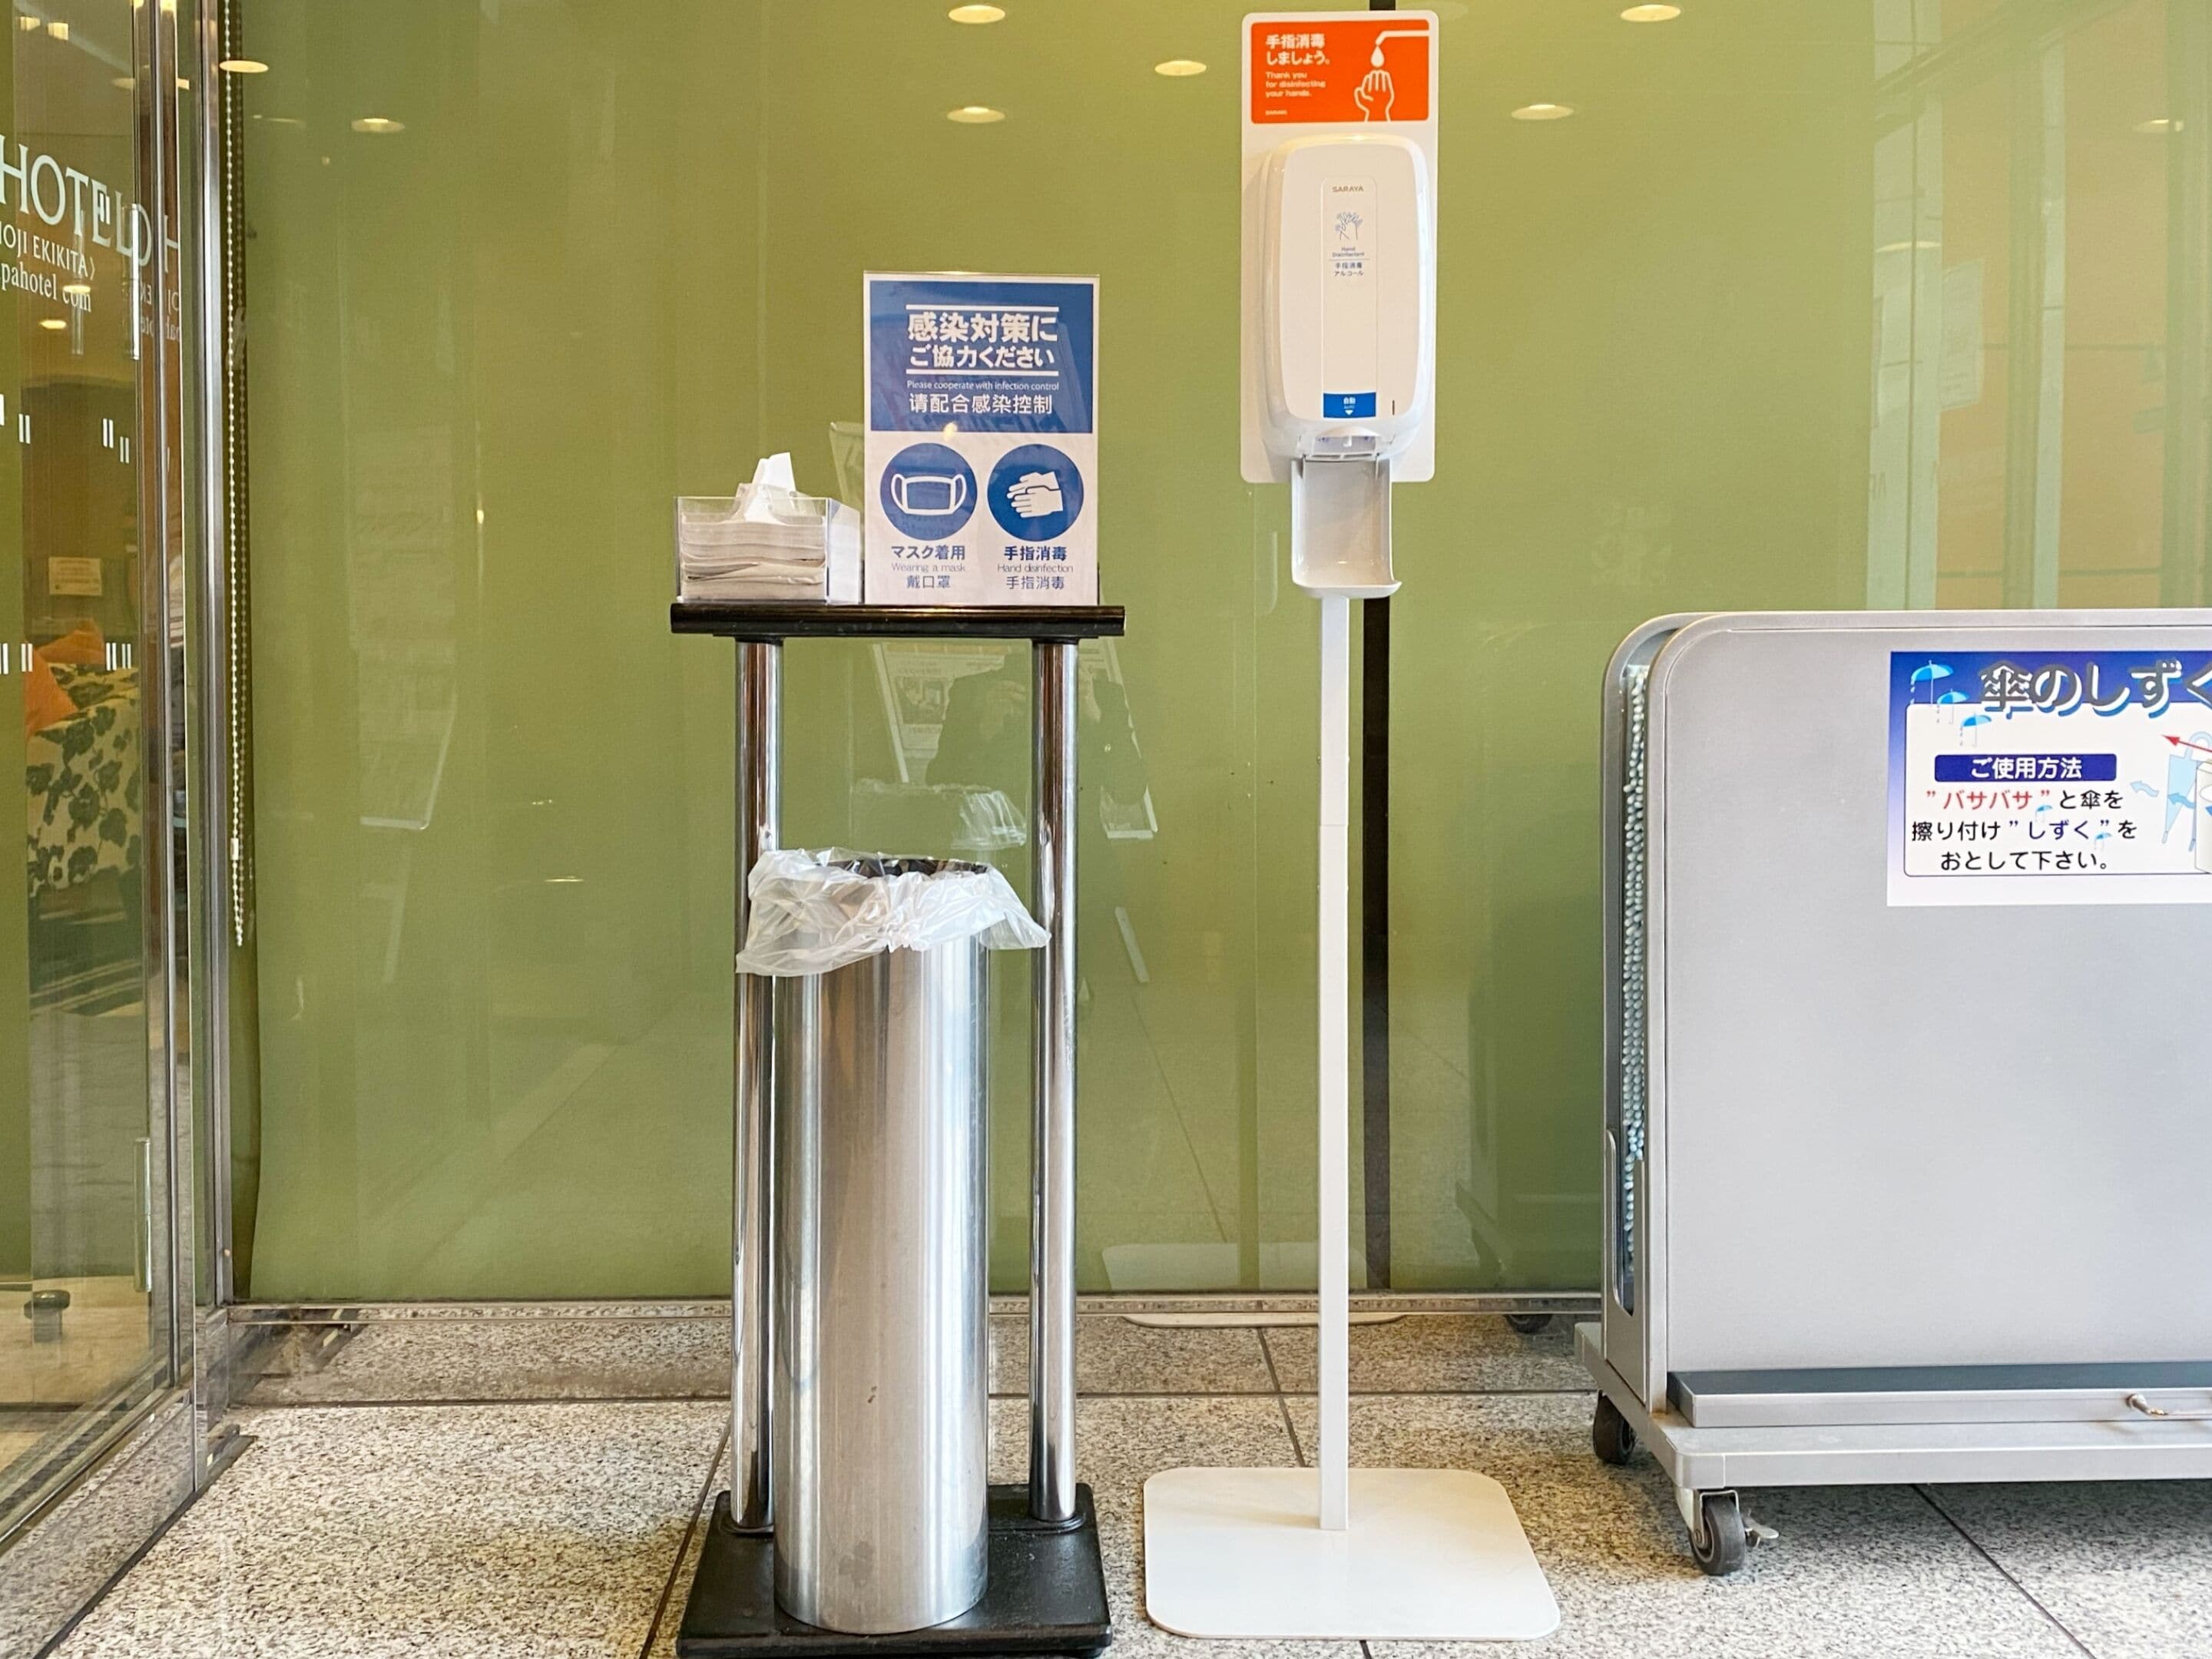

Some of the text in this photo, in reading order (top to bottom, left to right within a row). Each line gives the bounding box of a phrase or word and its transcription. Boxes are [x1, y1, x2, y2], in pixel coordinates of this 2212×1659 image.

[1266, 33, 1325, 49] 手指消毒
[1267, 50, 1330, 65] しましょう。
[1266, 71, 1290, 79] Thank
[0, 220, 28, 258] OJI
[908, 312, 1058, 343] 感染対策に
[910, 344, 1055, 369] ご協力ください
[907, 380, 1059, 391] Please cooperate with infection control
[909, 393, 1052, 415] 请配合感染控制
[891, 545, 965, 560] マスク着用
[1004, 545, 1067, 561] 手指消毒
[891, 563, 929, 573] Wearing
[941, 563, 966, 571] mask
[998, 563, 1074, 572] Hand disinfection
[906, 575, 951, 589] 戴口罩
[1006, 576, 1065, 590] 手指消毒
[1971, 757, 2082, 780] ご使用方法
[1941, 850, 2108, 871] おとして下さい。
